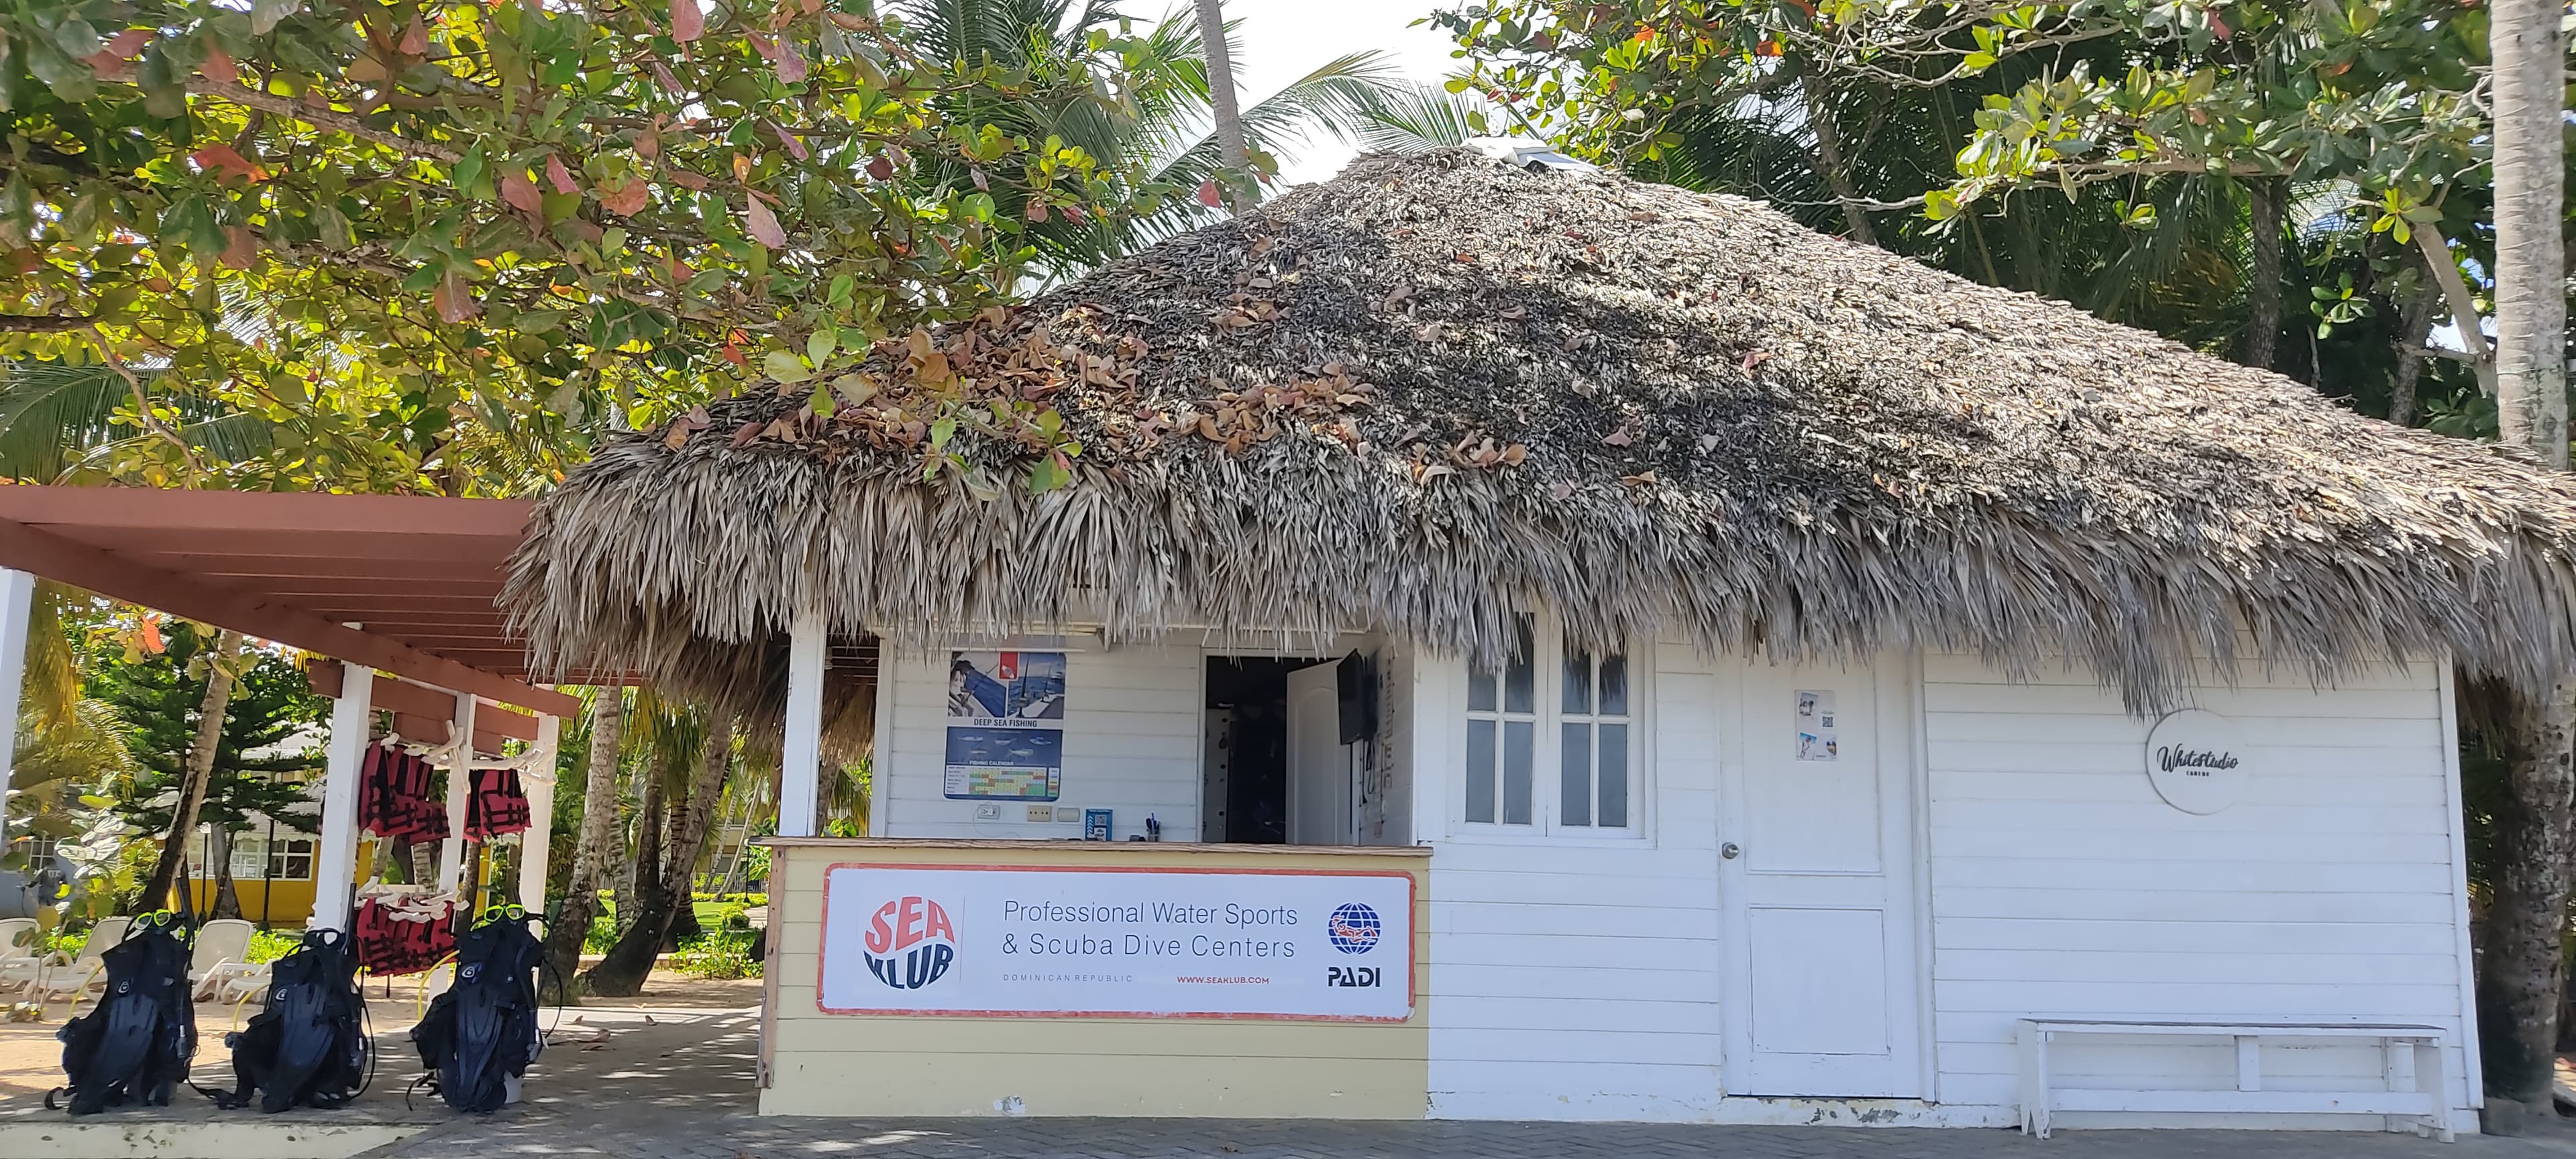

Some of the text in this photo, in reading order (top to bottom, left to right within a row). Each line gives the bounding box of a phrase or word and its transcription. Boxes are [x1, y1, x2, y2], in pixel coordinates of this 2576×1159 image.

[865, 896, 955, 954] SEA
[1005, 901, 1297, 930] Professional Water Sports
[1002, 933, 1295, 957] & Scuba Dive Centers
[863, 944, 954, 989] KLUB
[1328, 967, 1381, 987] PADI
[1177, 976, 1269, 984] WWW.SEAKLUB.COM
